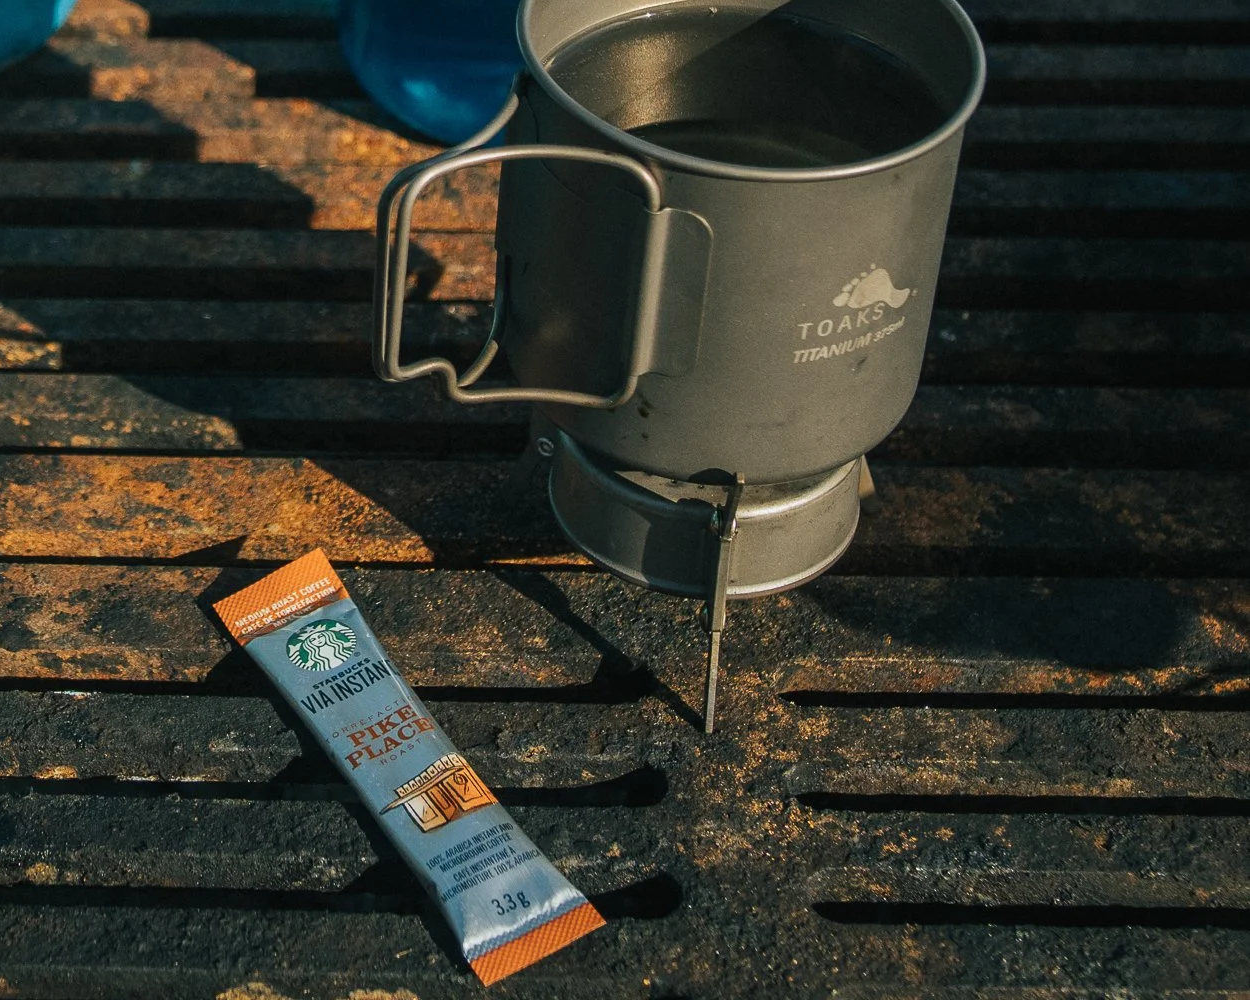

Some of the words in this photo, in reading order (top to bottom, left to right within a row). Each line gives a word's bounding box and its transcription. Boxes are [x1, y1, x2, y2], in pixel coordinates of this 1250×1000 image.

[798, 302, 886, 340] TOAKS
[793, 332, 872, 364] TITANIUM
[235, 607, 271, 628] MEDIUM
[271, 591, 300, 611] ROAST
[299, 576, 332, 596] COFFEE
[262, 614, 275, 625] DE
[275, 586, 336, 618] TORREFACTION
[312, 657, 371, 690] STARBUCKS
[301, 690, 333, 714] VIA
[345, 717, 435, 770] PLACE
[346, 704, 418, 748] PIKE
[380, 738, 422, 765] ROAST
[426, 852, 446, 870] 100%
[445, 839, 473, 860] ARABICA
[471, 828, 499, 846] INSTANT
[498, 822, 514, 833] AND
[439, 844, 489, 873] MICROGROUND
[487, 832, 512, 849] COFFEE
[452, 865, 472, 883] CAFÉ
[470, 848, 510, 875] INSTANTANÉ
[491, 893, 517, 916] 3.3
[516, 890, 531, 909] g
